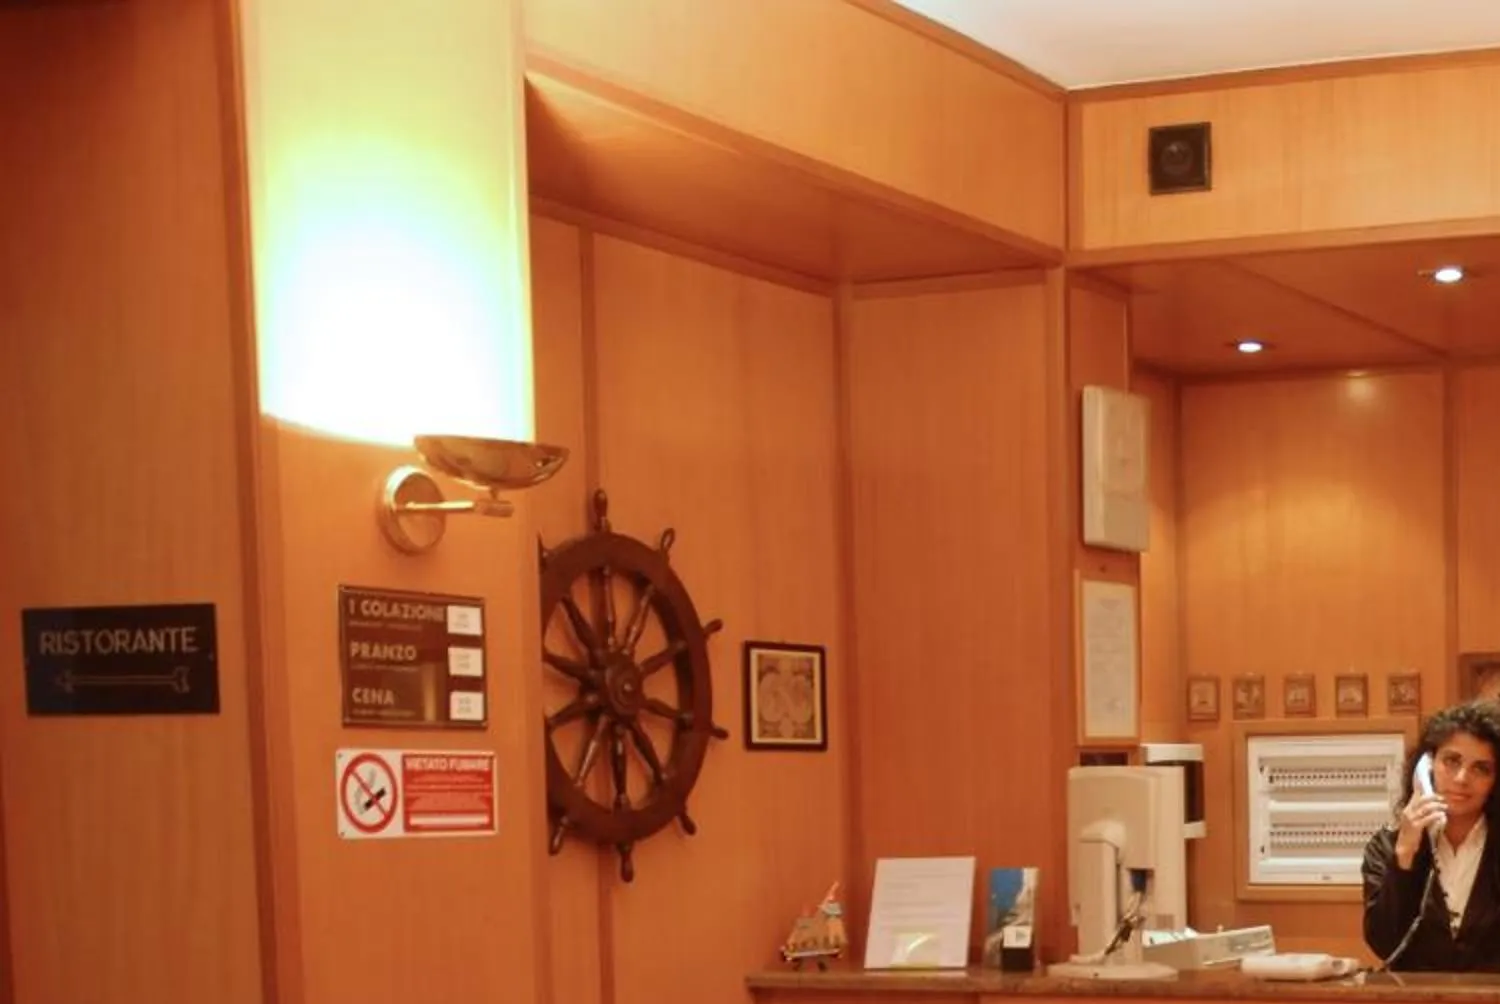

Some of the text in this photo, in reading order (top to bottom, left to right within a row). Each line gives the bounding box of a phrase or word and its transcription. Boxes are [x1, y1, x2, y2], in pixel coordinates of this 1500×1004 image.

[360, 599, 445, 622] COLAZIONE
[39, 626, 199, 656] RISTORANTE
[350, 641, 417, 661] PRANZO
[351, 686, 395, 706] CENA
[405, 757, 448, 771] VIETATO
